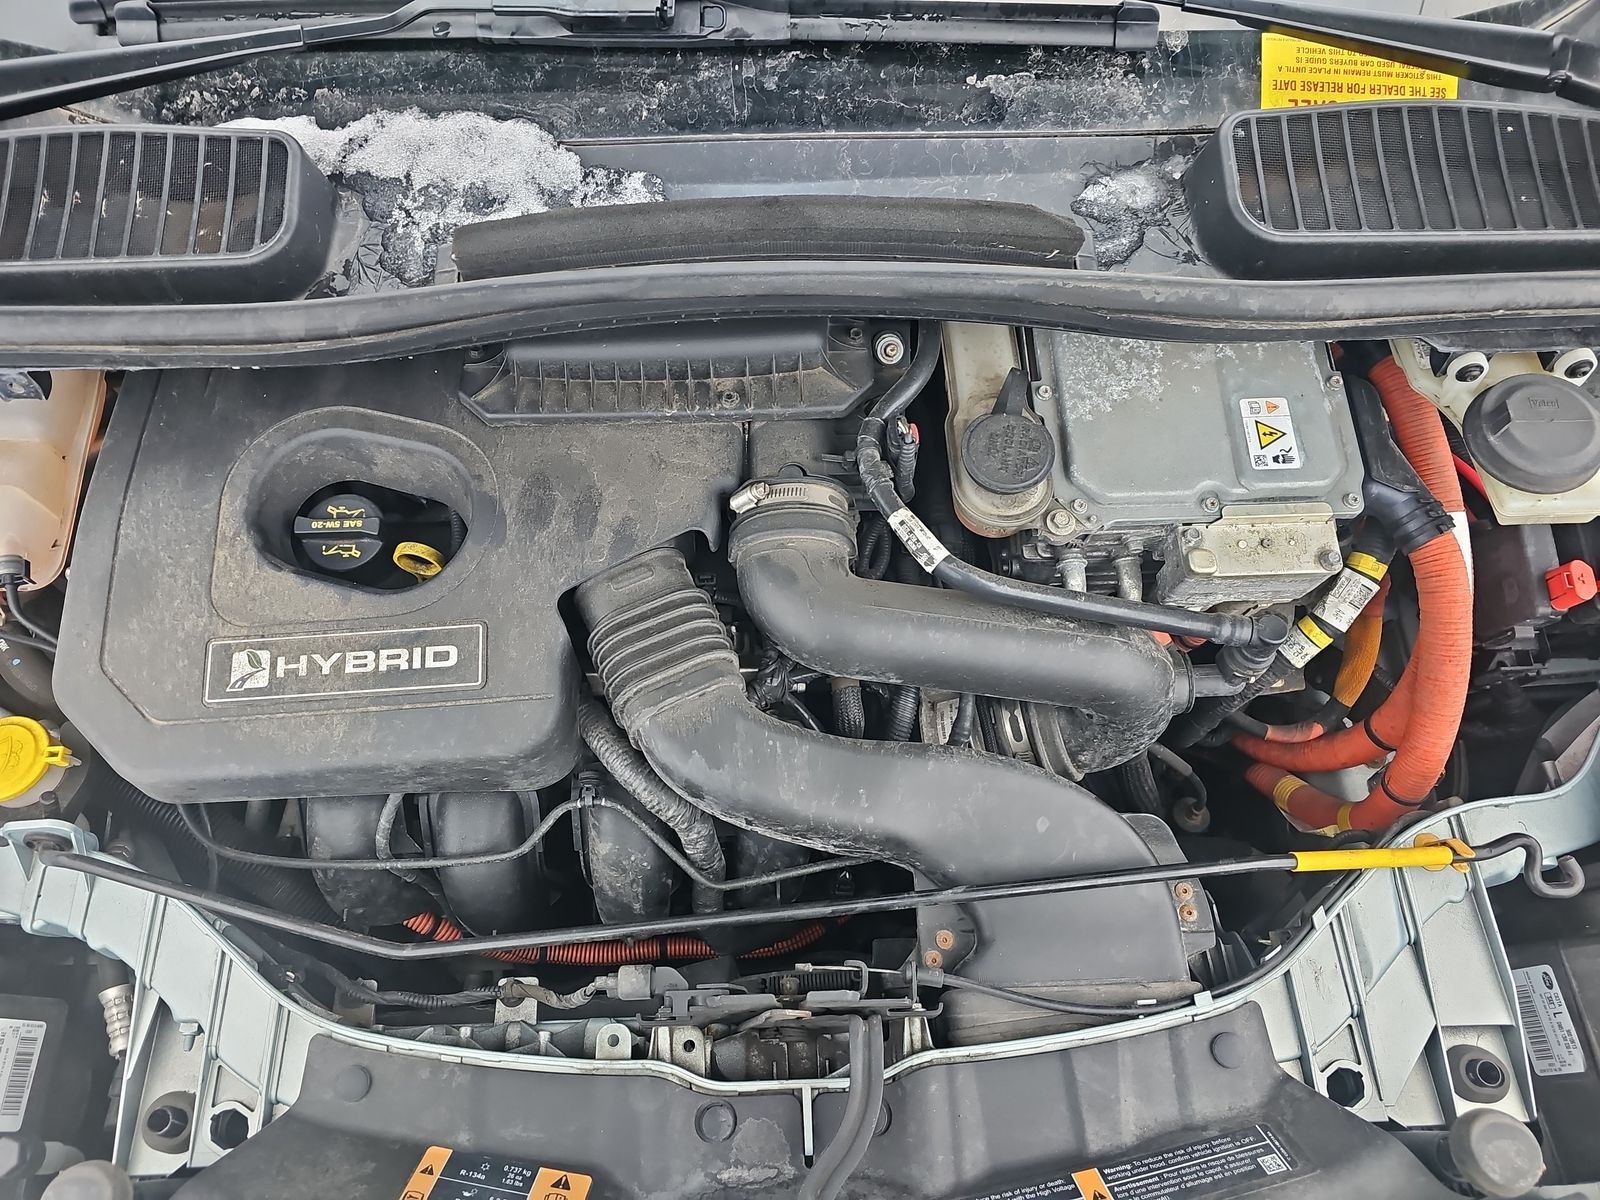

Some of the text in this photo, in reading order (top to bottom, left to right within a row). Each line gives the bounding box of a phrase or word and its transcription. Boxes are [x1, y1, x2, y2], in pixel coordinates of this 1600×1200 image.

[1296, 47, 1326, 55] VEHICLE
[1328, 48, 1345, 56] THIS
[1360, 59, 1375, 67] CAR
[1376, 60, 1395, 68] USED
[1343, 68, 1371, 76] REMAIN
[1373, 70, 1393, 78] MUST
[1395, 71, 1424, 79] STICKER
[1272, 79, 1446, 98] SEE THE DEALER FOR RELEASE DATE
[311, 520, 341, 528] 5W-20
[1293, 646, 1305, 657] CLIP
[276, 645, 458, 678] HYBRID
[1542, 972, 1553, 989] Ford
[1103, 1163, 1132, 1175] Warning:
[1142, 1156, 1162, 1164] reduce
[1211, 1137, 1231, 1145] before
[1107, 1171, 1131, 1180] working
[1168, 1155, 1190, 1164] confirm
[1191, 1149, 1212, 1157] vehicle
[1213, 1143, 1234, 1152] ignition
[1241, 1136, 1256, 1144] OFF.
[460, 1169, 485, 1180] R-134a
[504, 1165, 532, 1177] 0.737 kg
[1114, 1177, 1159, 1192] Avertissement
[1164, 1171, 1178, 1179] Pour
[1179, 1165, 1200, 1175] réduire
[1207, 1159, 1226, 1167] risque
[1235, 1148, 1264, 1159] blessures
[1147, 1178, 1181, 1190] intervention
[1183, 1173, 1197, 1181] sous
[1224, 1158, 1251, 1169] s'assurer
[1141, 1186, 1179, 1200] commutateur
[1181, 1175, 1213, 1188] d'allumage
[1233, 1164, 1257, 1175] position
[1021, 1187, 1038, 1195] injury
[1036, 1189, 1051, 1197] High
[1052, 1183, 1075, 1193] Voltage
